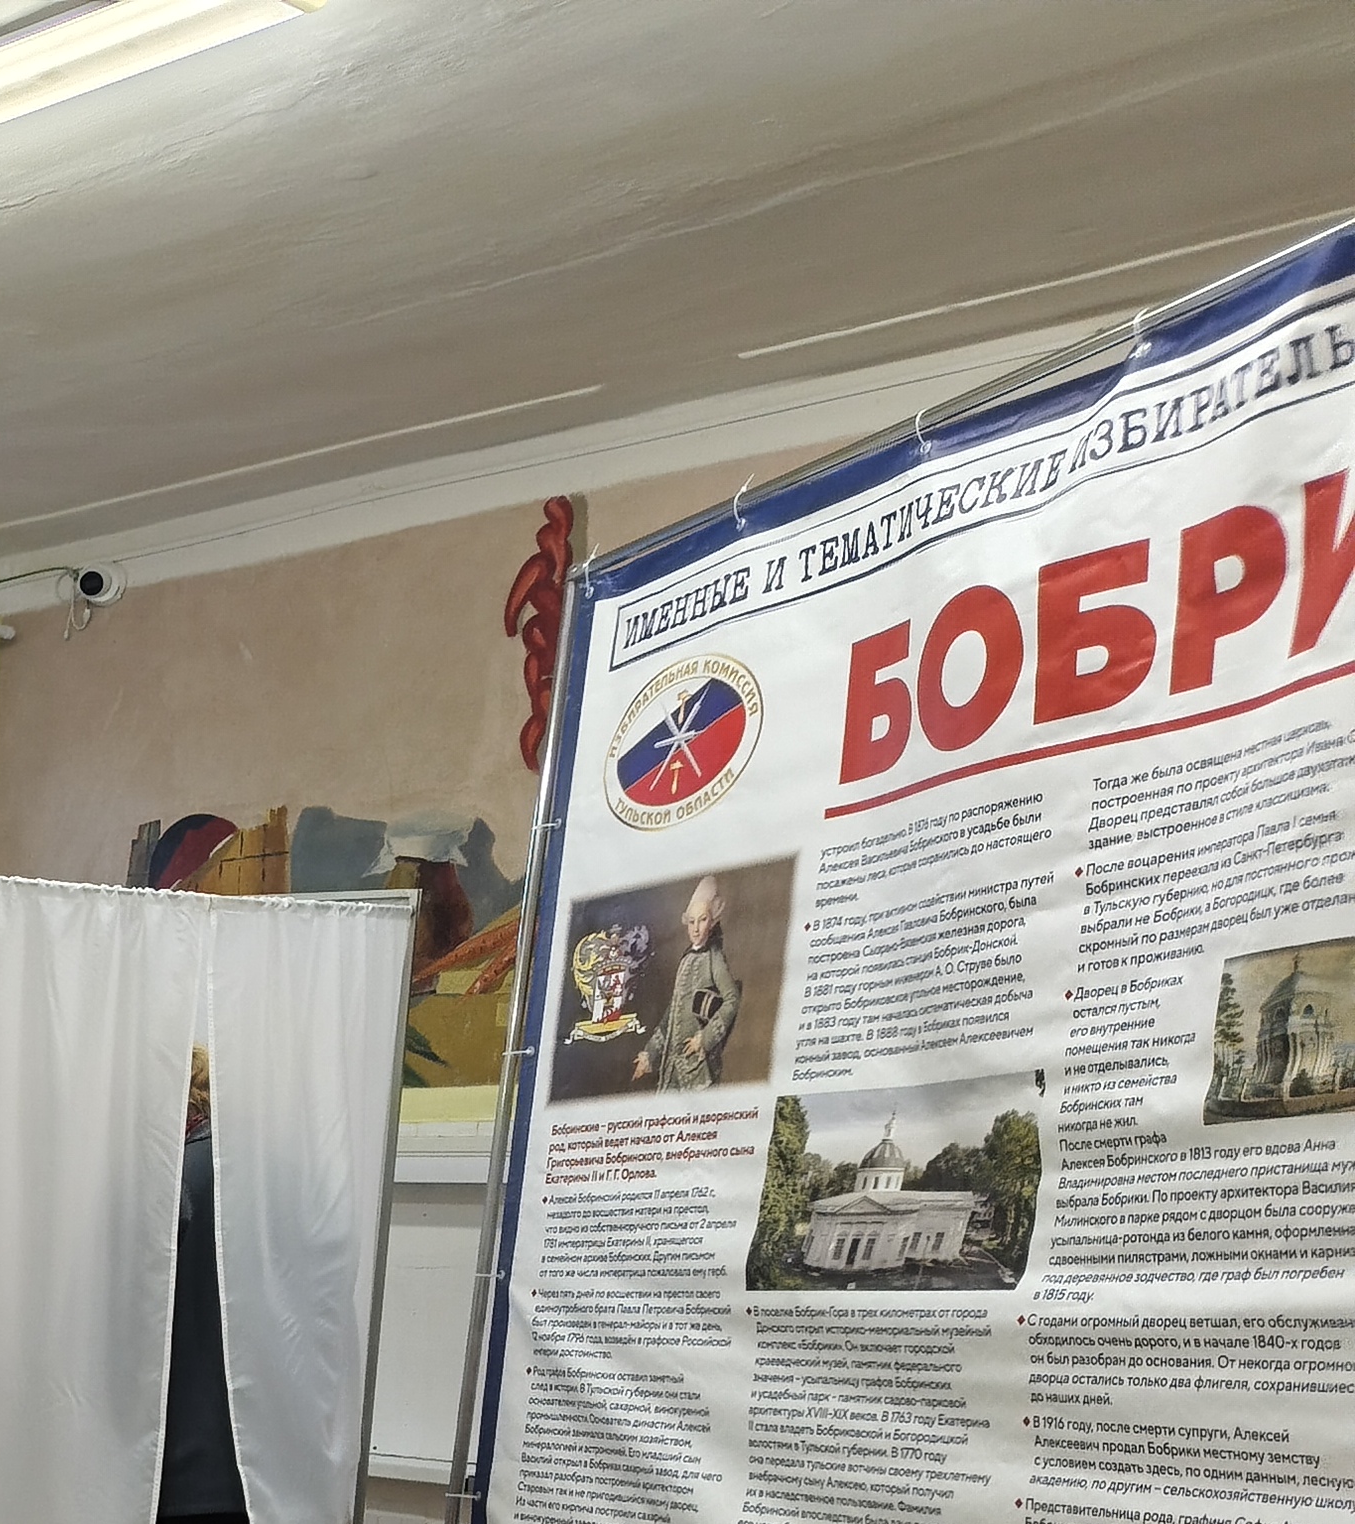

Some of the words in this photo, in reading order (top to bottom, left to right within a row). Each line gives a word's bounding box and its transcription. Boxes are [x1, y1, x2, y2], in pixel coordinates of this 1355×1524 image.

[623, 567, 751, 650] ИМЕННЫЕ
[762, 557, 787, 593] И
[798, 449, 1068, 583] ТЕМАТИЧЕСКИЕ
[609, 660, 699, 758] ИЗБИРАТЕЛЬНАЯ
[702, 659, 759, 718] КОМИССИЯ
[1092, 776, 1128, 791] Тогда
[1130, 772, 1149, 784] же
[1151, 765, 1183, 780] была
[1185, 749, 1242, 773] освящена
[614, 797, 672, 826] ТУЛЬСКОЙ
[675, 768, 736, 820] ОБЛАСТИ
[1091, 786, 1174, 811] построенная
[1176, 782, 1193, 794] по
[1194, 769, 1241, 793] проекту
[1086, 861, 1125, 877] После
[1127, 848, 1195, 869] воцарения
[1073, 985, 1119, 1002] Дворец
[1120, 984, 1127, 994] в
[1129, 976, 1184, 993] Бобриках
[1073, 1004, 1117, 1019] остался
[1117, 998, 1161, 1016] пустым,
[1061, 1158, 1105, 1171] Алексея
[1106, 1152, 1178, 1169] Бобринского
[1180, 1152, 1187, 1162] в
[1189, 1146, 1212, 1161] 1813
[1214, 1147, 1241, 1161] году
[1242, 1146, 1263, 1157] его
[1265, 1142, 1301, 1157] вдова
[1302, 1138, 1336, 1152] Анна
[1056, 1194, 1101, 1211] выбрала
[1101, 1191, 1150, 1208] Бобрики.
[1152, 1189, 1168, 1203] По
[1170, 1189, 1219, 1205] проекту
[1220, 1185, 1299, 1202] архитектора
[1054, 1214, 1118, 1227] Милинского
[1119, 1215, 1126, 1225] в
[1127, 1212, 1160, 1227] парке
[1161, 1211, 1198, 1226] рядом
[1199, 1210, 1207, 1221] с
[1208, 1208, 1262, 1223] дворцом
[1264, 1203, 1296, 1218] была
[1050, 1232, 1171, 1250] усыпальница-ротонда
[1172, 1231, 1186, 1242] из
[1187, 1227, 1230, 1242] белого
[1232, 1228, 1272, 1240] камня,
[1027, 1313, 1038, 1326] С
[1038, 1317, 1078, 1329] годами
[1080, 1314, 1139, 1331] огромный
[1141, 1317, 1187, 1331] дворец
[1189, 1317, 1241, 1330] ветшал,
[1242, 1318, 1265, 1328] его
[1028, 1332, 1096, 1347] обходилось
[1097, 1337, 1133, 1347] очень
[1134, 1337, 1181, 1351] дорого,
[1183, 1338, 1191, 1348] и
[1193, 1338, 1201, 1348] в
[1203, 1338, 1250, 1349] начале
[1252, 1334, 1298, 1349] 1840-х
[1301, 1339, 1341, 1352] годов
[1030, 1354, 1045, 1364] он
[1046, 1351, 1070, 1365] был
[1071, 1352, 1126, 1369] разобран
[1127, 1357, 1143, 1369] до
[1145, 1357, 1215, 1368] основания.
[1217, 1355, 1236, 1369] От
[1238, 1359, 1290, 1373] некогда
[1028, 1374, 1070, 1387] дворца
[1072, 1375, 1124, 1386] остались
[1127, 1376, 1168, 1387] только
[1169, 1378, 1191, 1390] два
[1194, 1375, 1250, 1392] флигеля,
[1030, 1392, 1044, 1403] до
[1045, 1393, 1081, 1404] наших
[1082, 1392, 1113, 1406] дней.
[1032, 1415, 1041, 1428] В
[1042, 1416, 1065, 1430] 1916
[1067, 1420, 1094, 1434] году,
[1096, 1422, 1131, 1433] после
[1132, 1424, 1176, 1438] смерти
[1178, 1427, 1231, 1442] супруги,
[1233, 1426, 1290, 1443] Алексей
[1034, 1434, 1100, 1452] Алексеевич
[1102, 1442, 1145, 1456] продал
[1147, 1441, 1201, 1460] Бобрики
[1203, 1448, 1265, 1465] местному
[1267, 1452, 1320, 1469] земству
[1034, 1456, 1041, 1466] с
[1041, 1457, 1097, 1470] условием
[1098, 1461, 1144, 1474] создать
[1146, 1464, 1183, 1478] здесь,
[1185, 1467, 1201, 1478] по
[1203, 1468, 1243, 1481] одним
[1245, 1472, 1300, 1487] данным,
[1029, 1475, 1088, 1490] академию,
[1091, 1480, 1107, 1490] по
[1107, 1481, 1152, 1495] другим
[1163, 1485, 1314, 1509] сельскохозяйственную
[1025, 1498, 1141, 1523] Представительница
